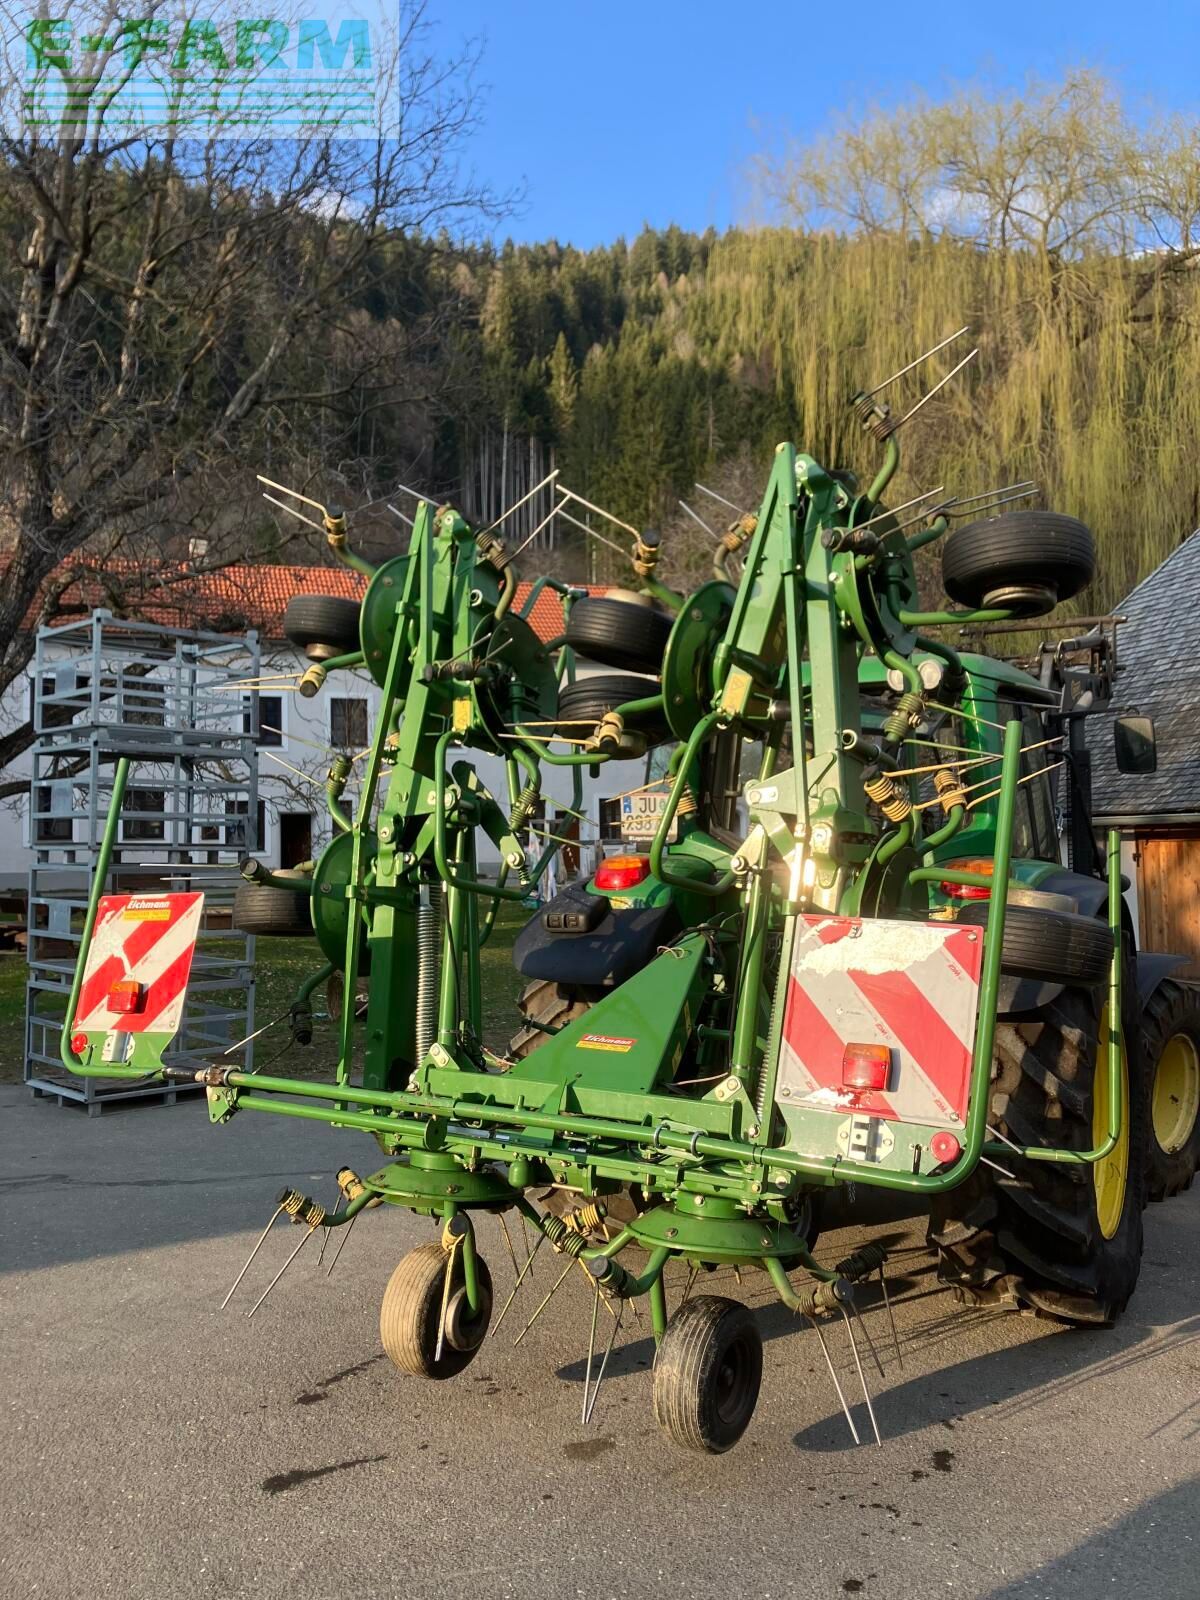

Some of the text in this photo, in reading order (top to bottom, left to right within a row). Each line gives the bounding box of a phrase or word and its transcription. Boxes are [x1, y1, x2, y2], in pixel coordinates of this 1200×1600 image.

[639, 797, 657, 813] JU
[127, 899, 171, 909] Eichmann
[584, 1035, 633, 1046] Eichmann
